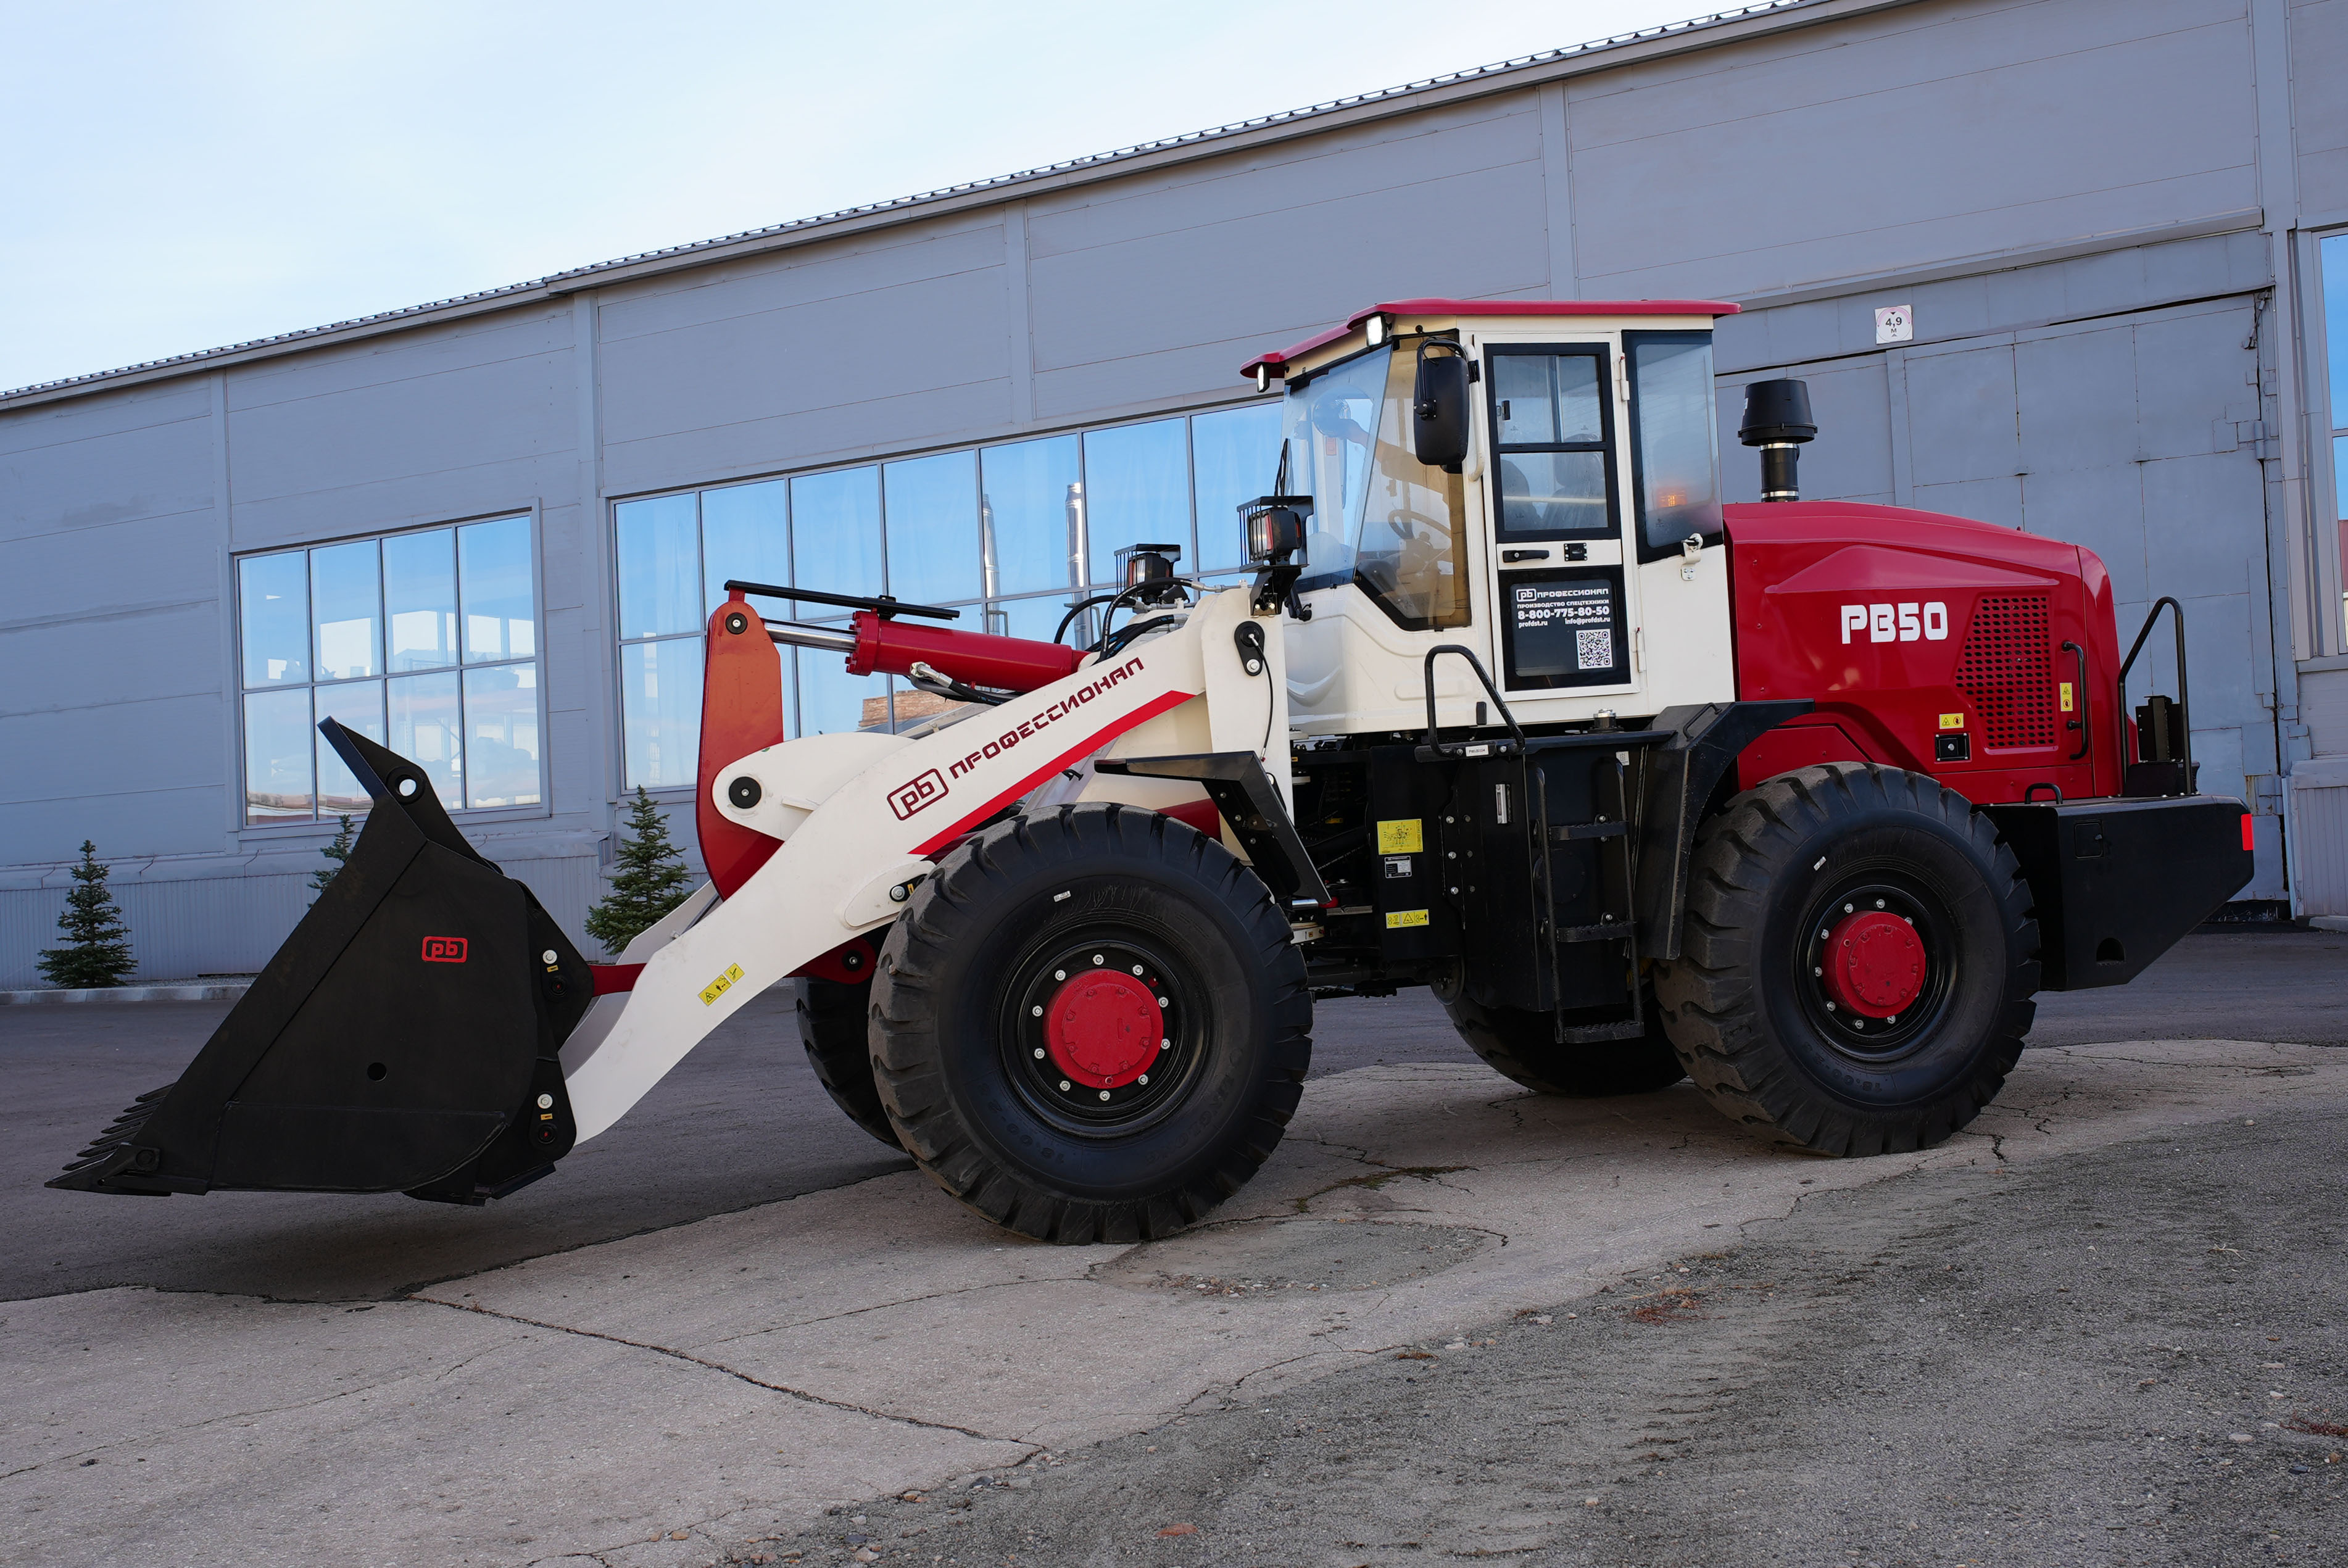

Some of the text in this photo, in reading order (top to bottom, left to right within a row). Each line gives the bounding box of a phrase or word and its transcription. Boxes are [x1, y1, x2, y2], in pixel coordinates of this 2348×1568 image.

[1885, 317, 1902, 328] 4,9
[1537, 588, 1609, 599] ПРОФЕССИОНАЛ
[1517, 601, 1566, 609] ПРОИЗВОДСТВО
[1517, 605, 1610, 620] 8-800-775-80-50
[1518, 620, 1548, 628] profdst.ru
[1564, 616, 1611, 625] info@profdst.ru
[1841, 601, 1949, 644] PB50
[948, 657, 1145, 779] ПРОФЕССИОНАЛ
